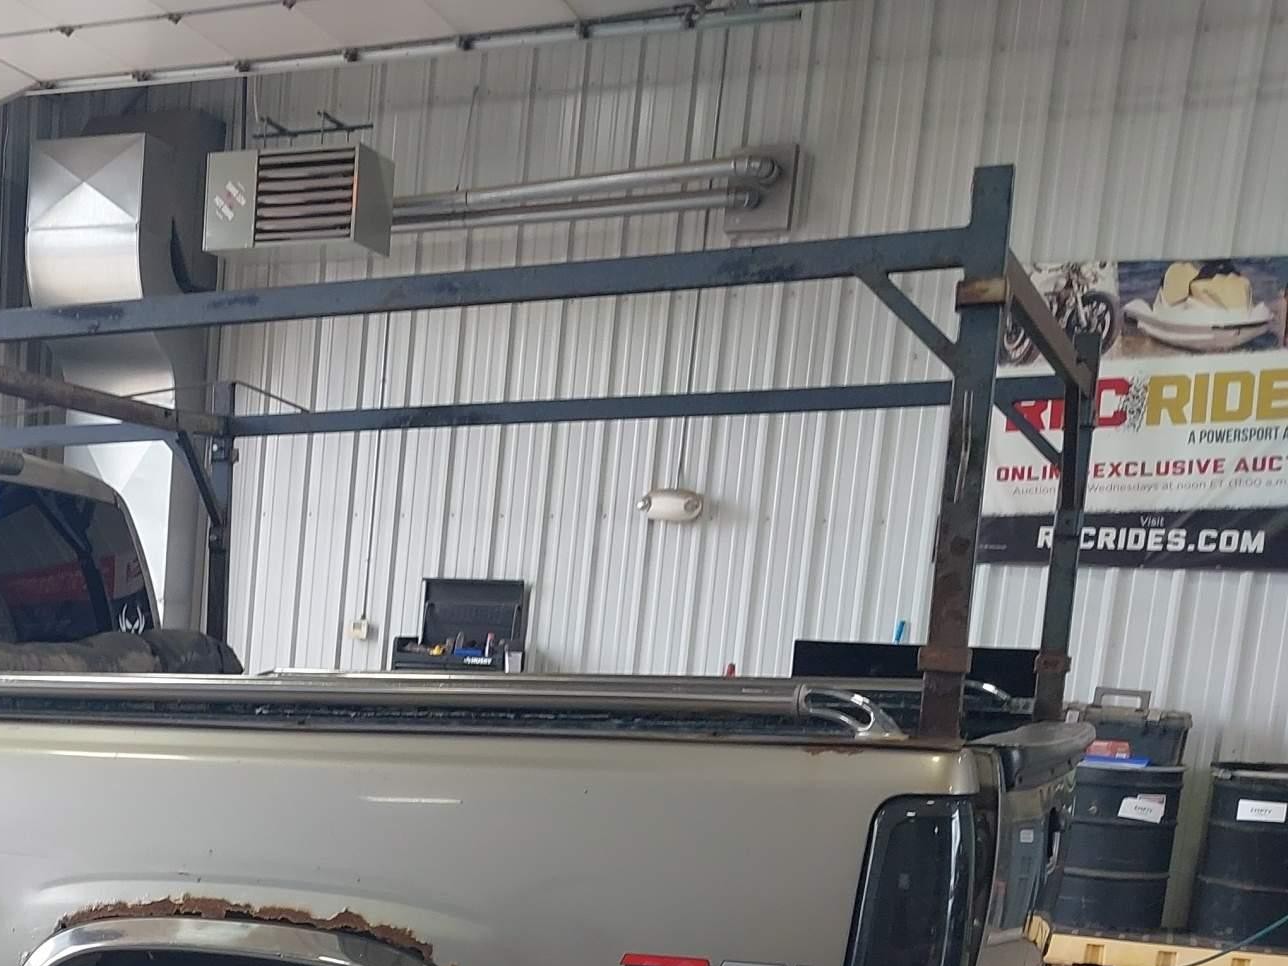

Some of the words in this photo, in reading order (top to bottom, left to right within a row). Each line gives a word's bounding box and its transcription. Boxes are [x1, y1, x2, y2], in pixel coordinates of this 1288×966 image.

[1188, 430, 1197, 445] A
[1199, 426, 1281, 444] POWERSPORT
[1093, 457, 1226, 479] EXCLUSIVE
[1140, 515, 1164, 528] Visit
[1037, 526, 1265, 554] RCRIDES.COM
